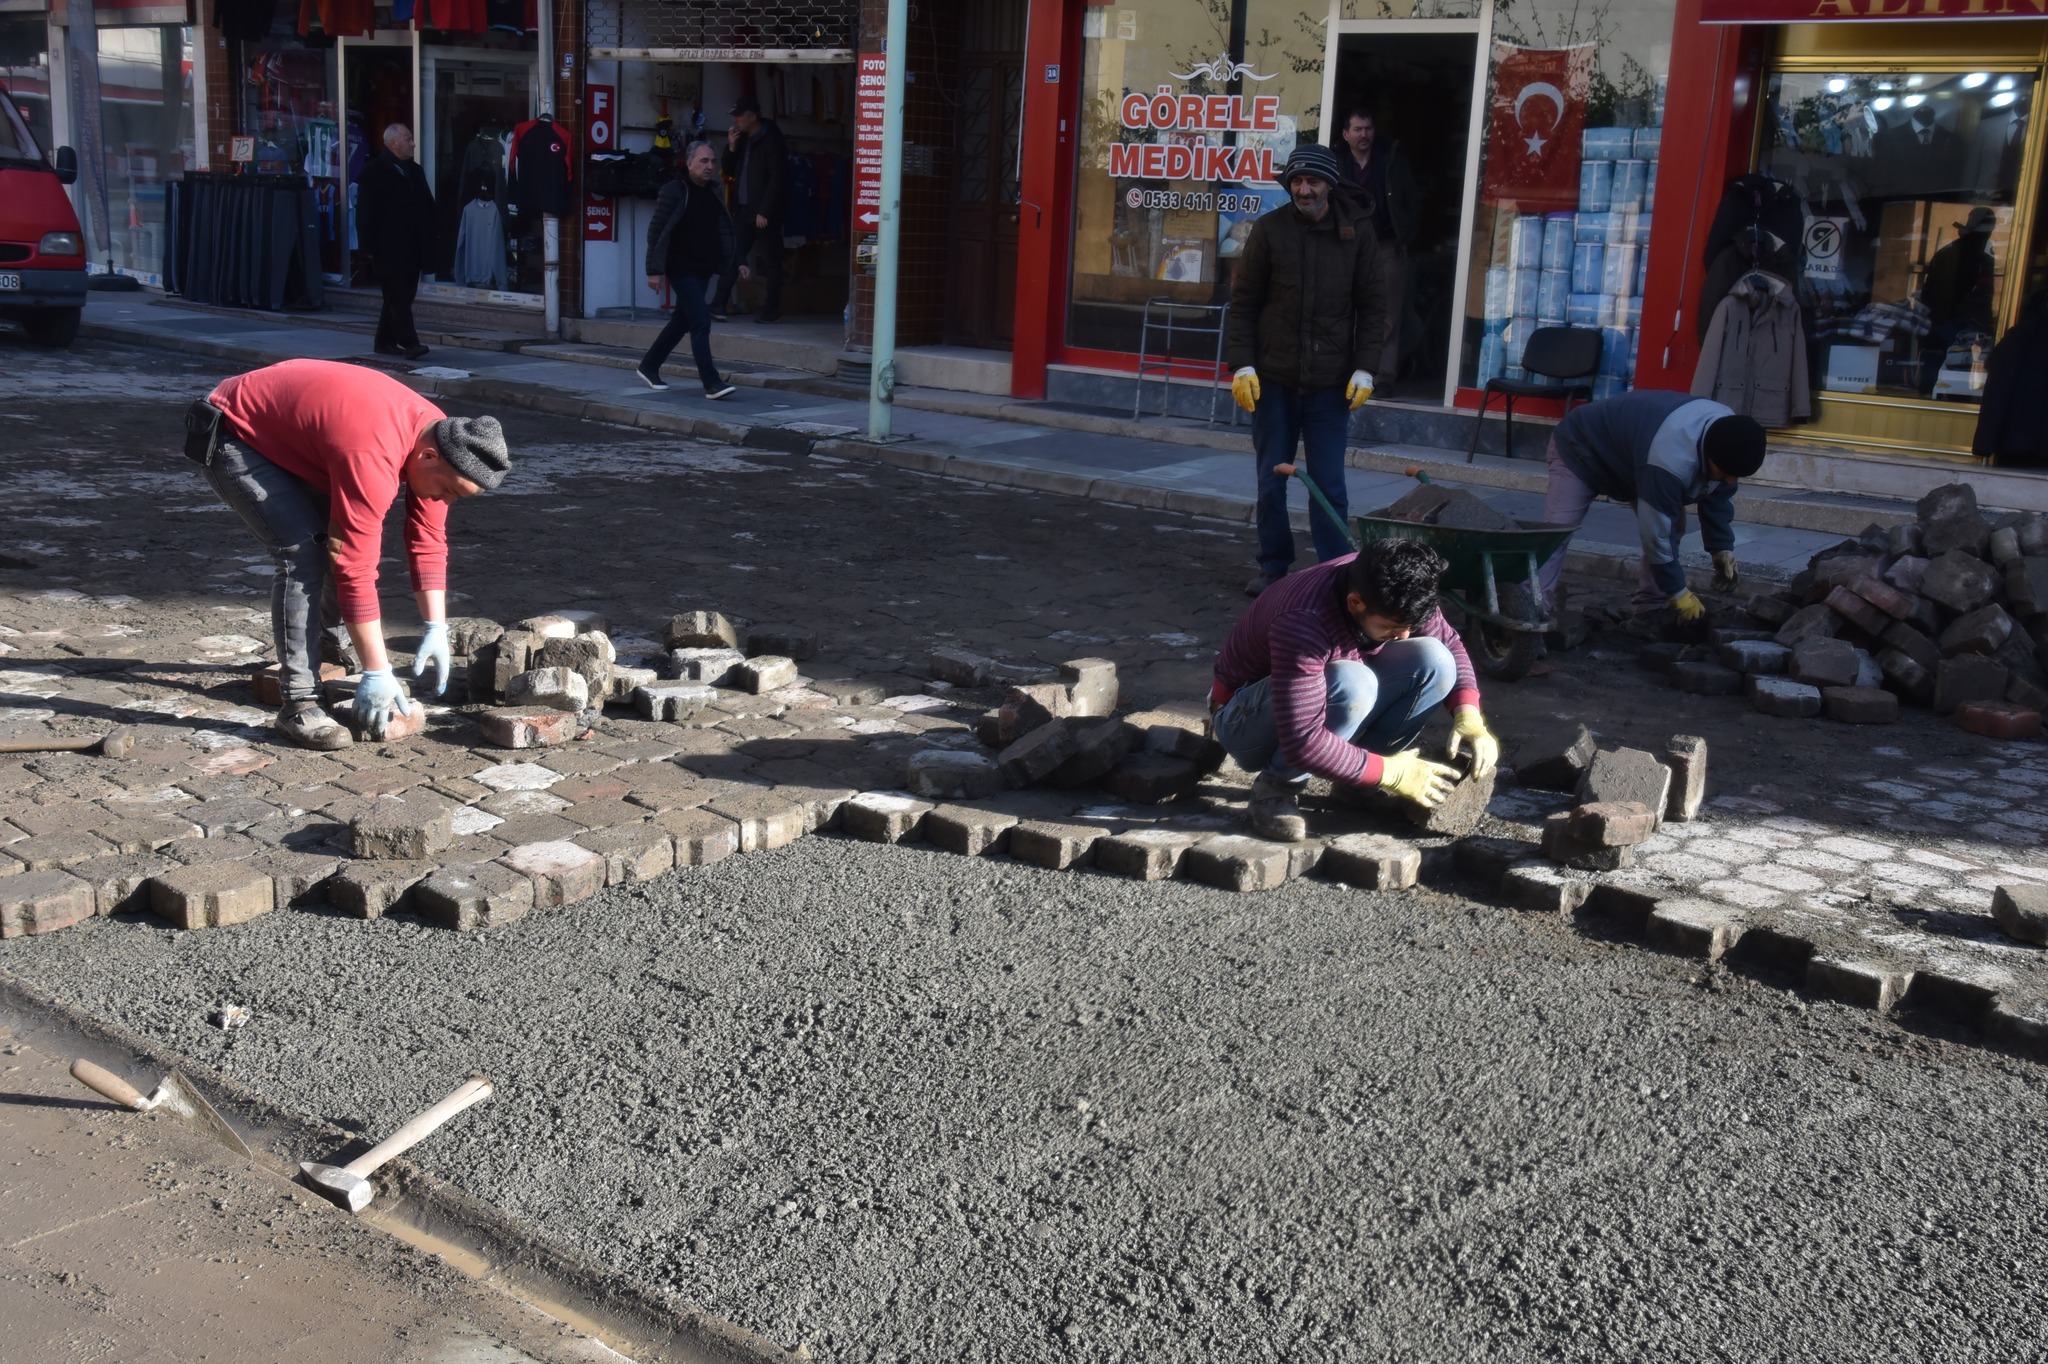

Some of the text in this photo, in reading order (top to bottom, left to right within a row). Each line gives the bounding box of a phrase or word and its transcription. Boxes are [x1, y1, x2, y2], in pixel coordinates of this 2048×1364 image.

[863, 60, 886, 70] FOTO
[860, 75, 886, 87] ŞENOL
[1121, 85, 1279, 132] GÖRELE
[235, 138, 250, 156] 75
[1109, 135, 1284, 184] MEDİKAL
[1142, 189, 1262, 214] 0533 411 28 47
[587, 207, 610, 217] ŞENOL
[0, 276, 18, 288] 08
